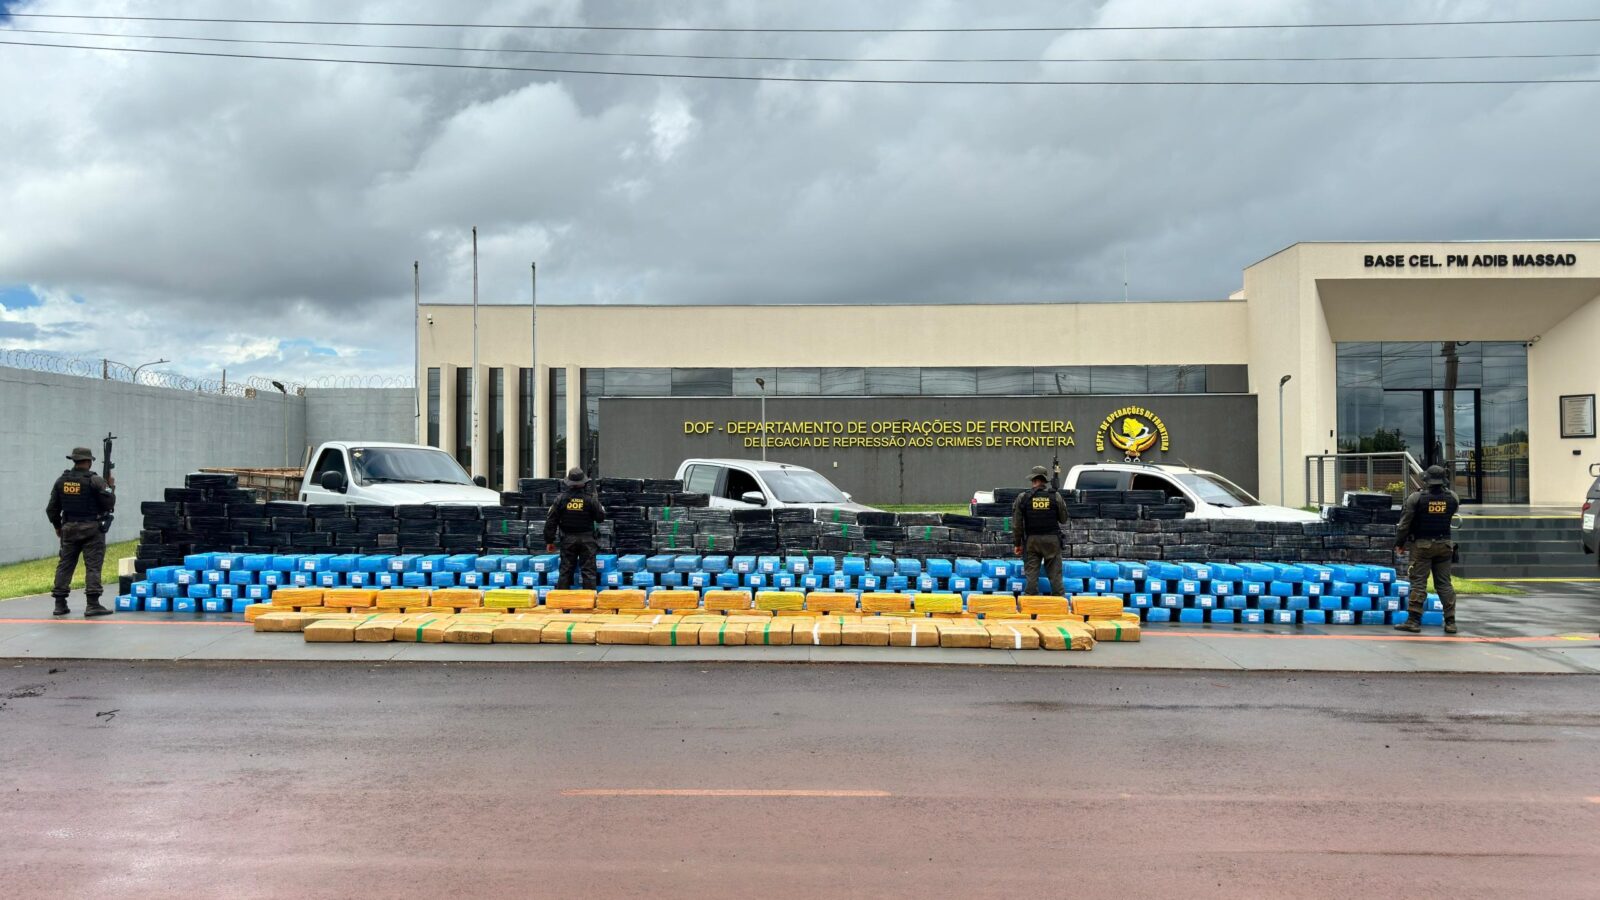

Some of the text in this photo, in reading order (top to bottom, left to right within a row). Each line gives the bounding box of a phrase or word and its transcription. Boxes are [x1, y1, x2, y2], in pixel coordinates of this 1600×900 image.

[1364, 254, 1576, 267] BASE CEL. PM ADIB MASSAD
[684, 421, 714, 434] DOF
[727, 421, 844, 434] DEPARTAMENTO
[847, 421, 868, 433] DE
[871, 419, 962, 436] OPERAÇÕES
[966, 421, 986, 433] DE
[990, 420, 1075, 433] FRONTEIRA
[1100, 420, 1110, 431] DE
[1106, 405, 1145, 423] OPERAÇÕES
[1144, 409, 1155, 420] DE
[1152, 416, 1169, 451] FRONTEIRA
[744, 437, 811, 448] DELEGACIA
[814, 437, 829, 447] DE
[833, 436, 906, 447] REPRESSÃO
[908, 437, 933, 447] AOS
[936, 436, 983, 447] CRIMES
[985, 436, 1003, 446] DE
